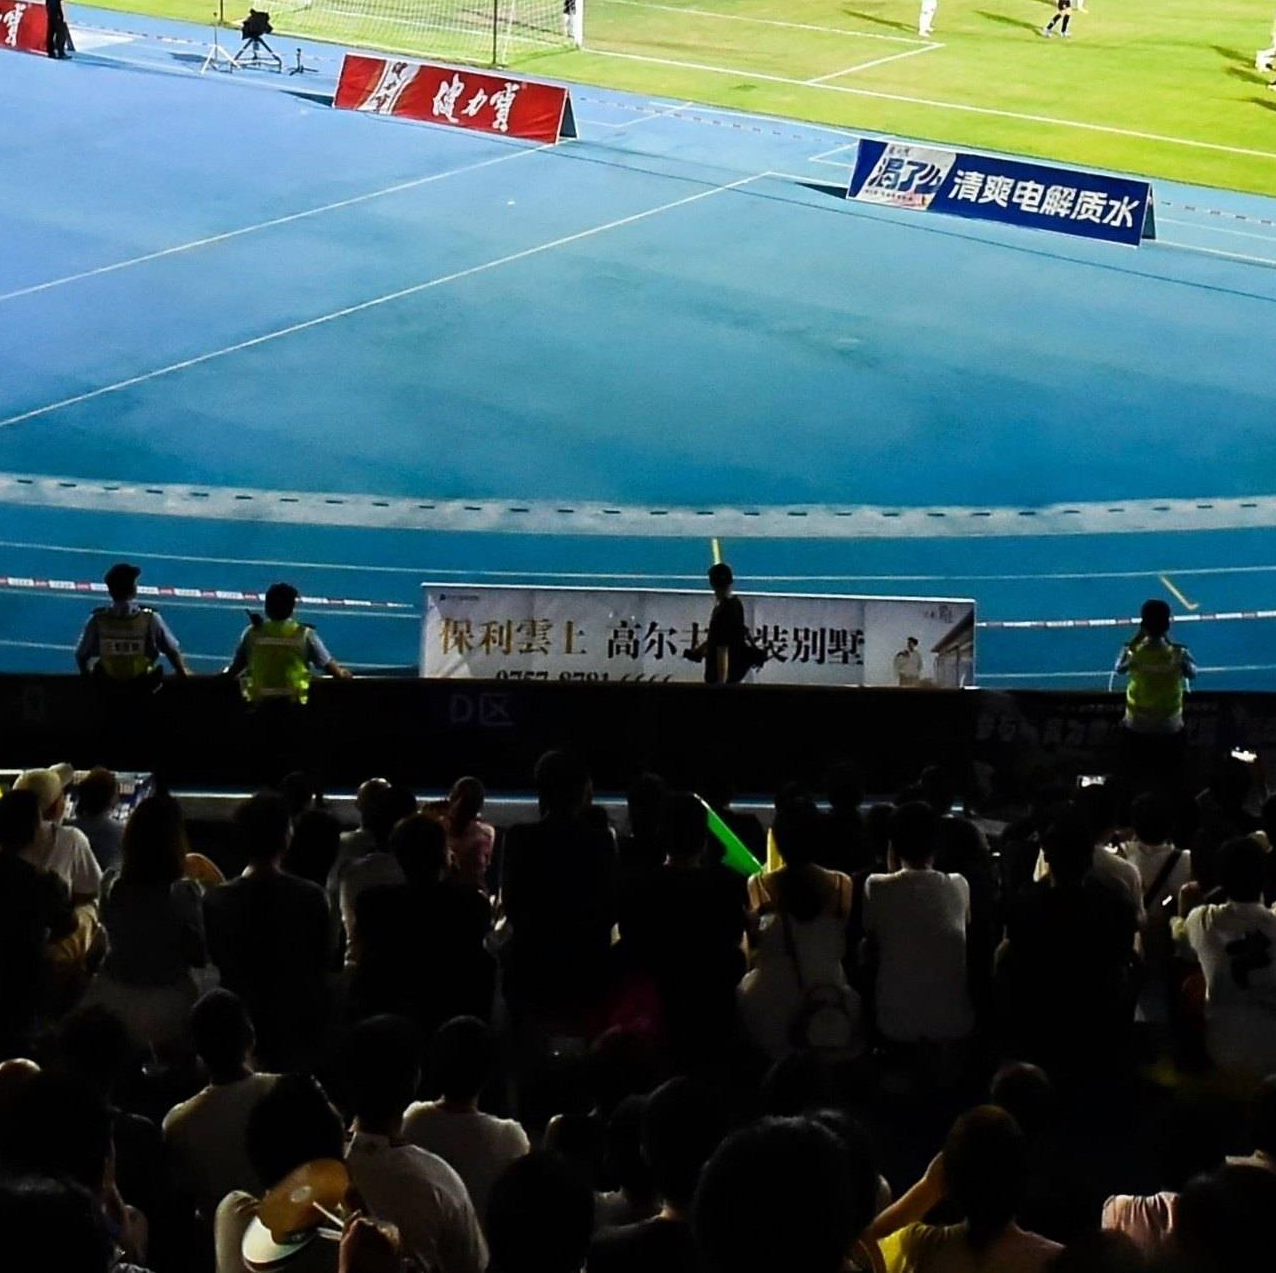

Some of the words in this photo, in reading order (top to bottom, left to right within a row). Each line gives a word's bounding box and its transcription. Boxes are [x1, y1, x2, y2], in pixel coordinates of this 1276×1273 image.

[948, 169, 1139, 228] 清爽电解质水
[606, 620, 865, 667] 高尔夫装别墅
